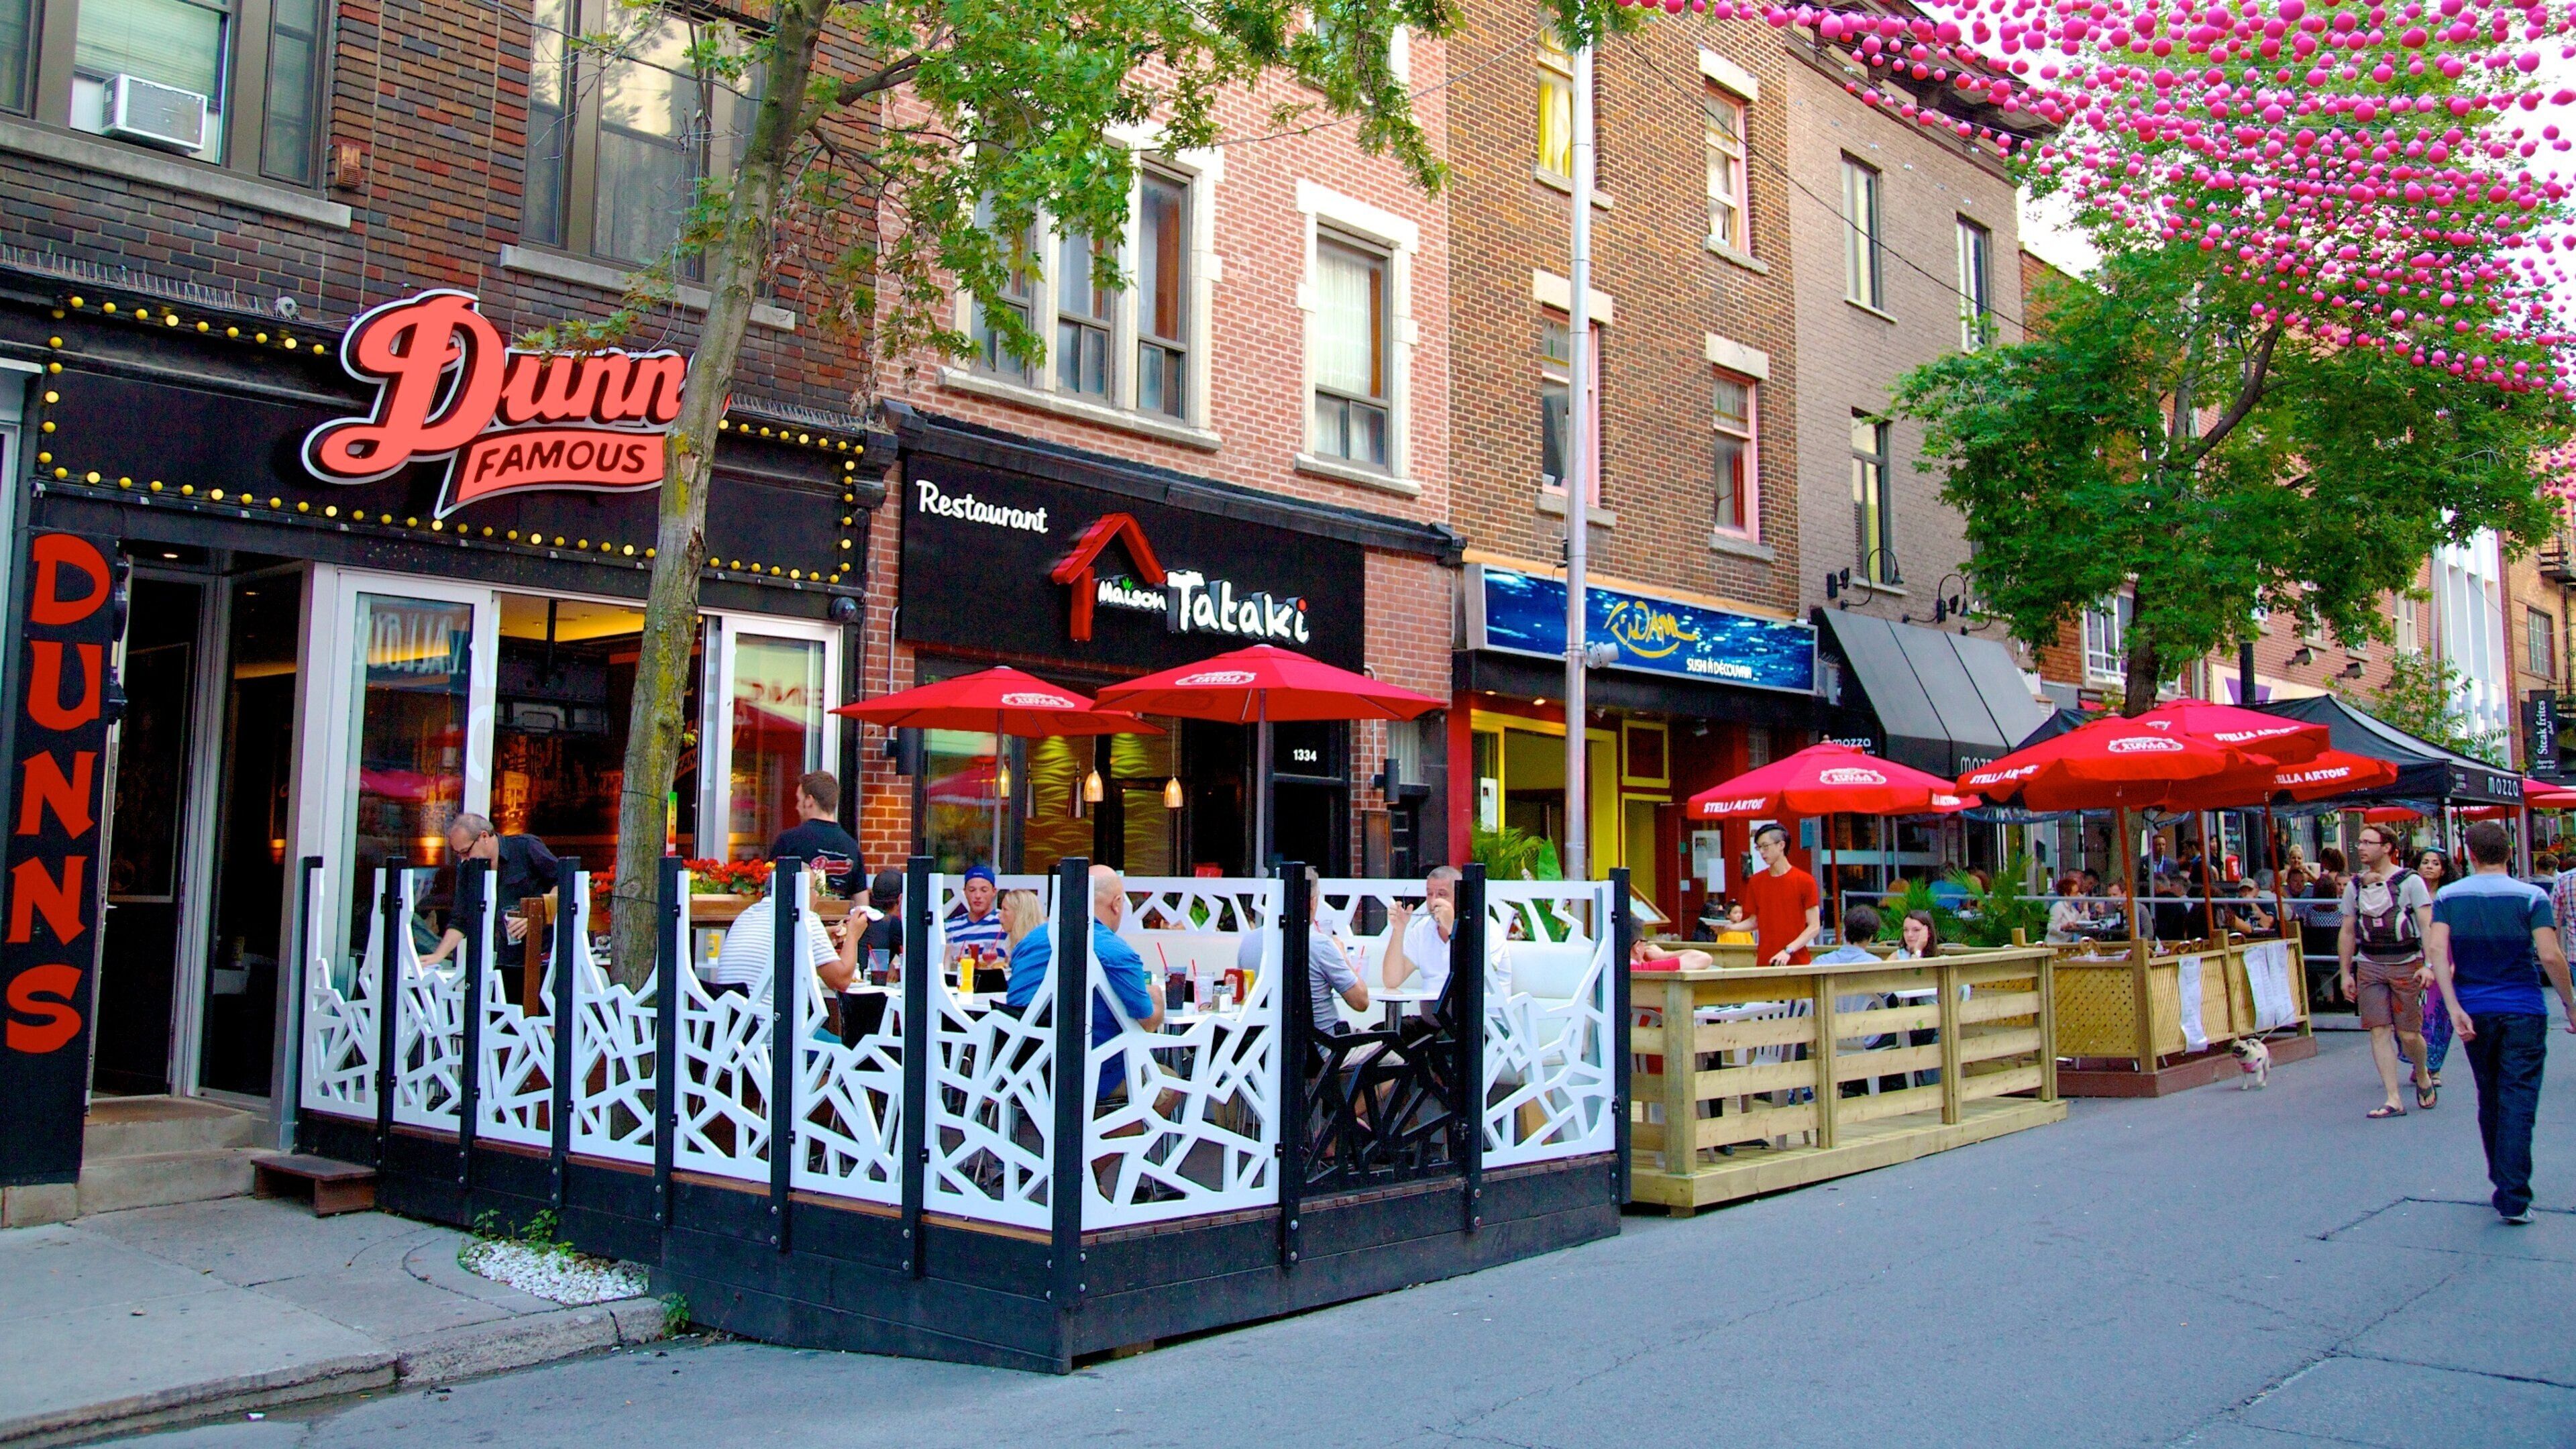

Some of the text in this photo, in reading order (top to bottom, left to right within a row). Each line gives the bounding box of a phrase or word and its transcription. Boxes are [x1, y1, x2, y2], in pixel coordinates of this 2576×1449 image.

[321, 295, 732, 475] Dunn
[474, 439, 647, 484] FAMOUS
[916, 480, 1049, 533] Restaurant
[1097, 570, 1310, 643] Maison Tataki
[2535, 700, 2546, 726] frites
[1293, 749, 1317, 761] 1334
[2536, 727, 2548, 755] Steak
[7, 533, 111, 1054] DUNNS
[2304, 767, 2349, 782] ARTOIS
